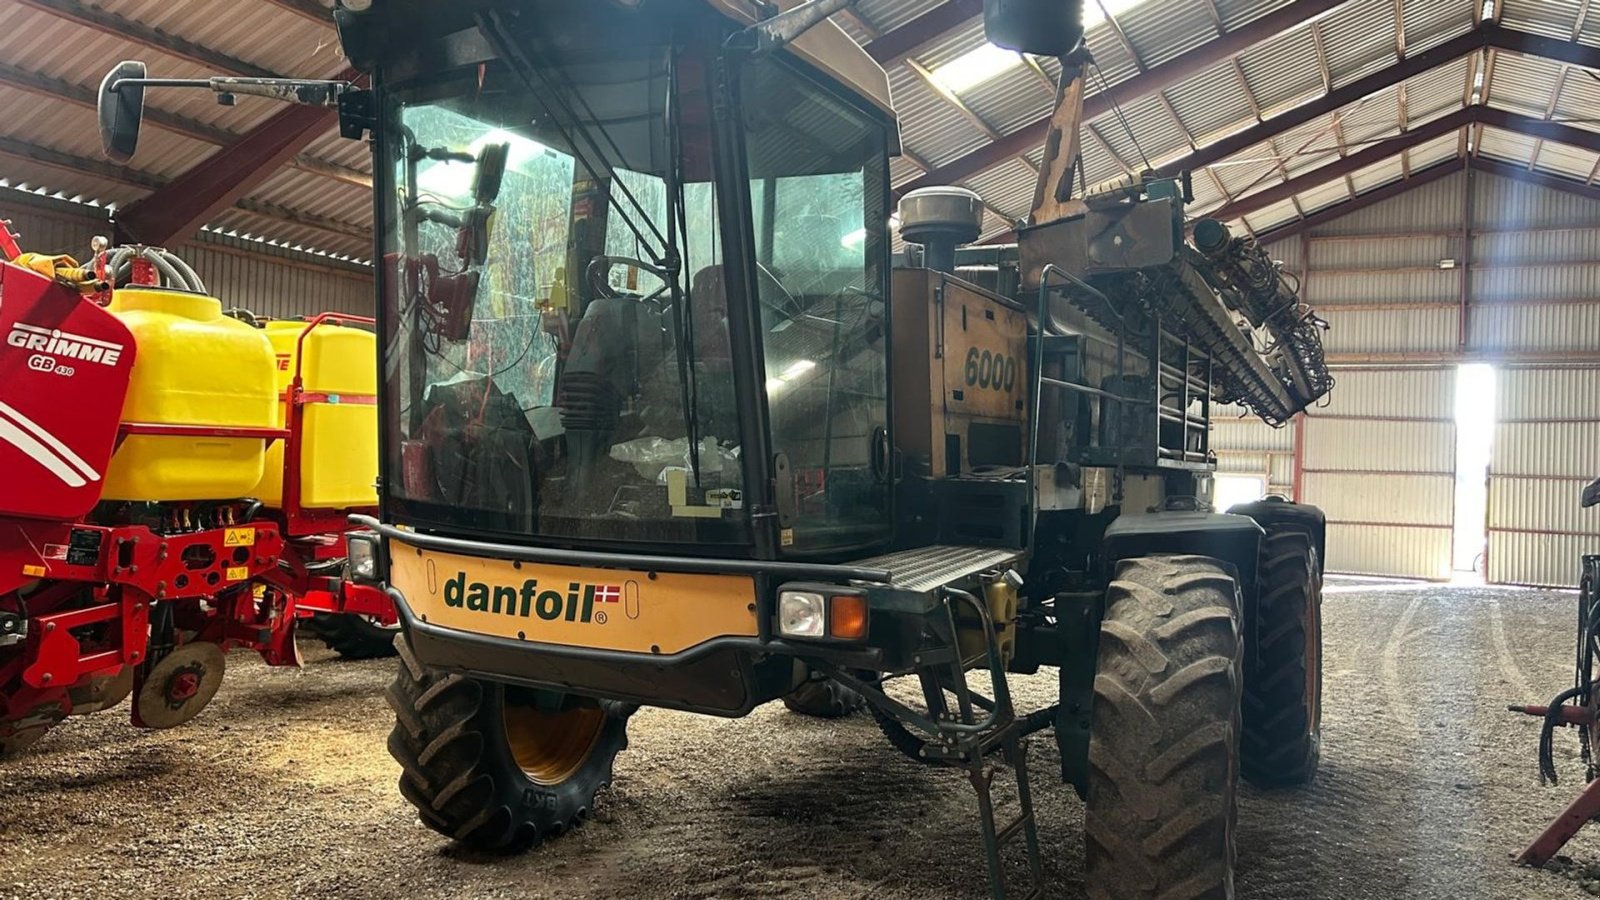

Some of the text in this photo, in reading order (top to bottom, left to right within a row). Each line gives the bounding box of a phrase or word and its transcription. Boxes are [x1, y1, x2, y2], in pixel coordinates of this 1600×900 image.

[7, 323, 123, 366] GRIMME
[29, 355, 74, 376] GB 430
[965, 346, 1015, 392] 6000
[444, 571, 595, 623] danfoil
